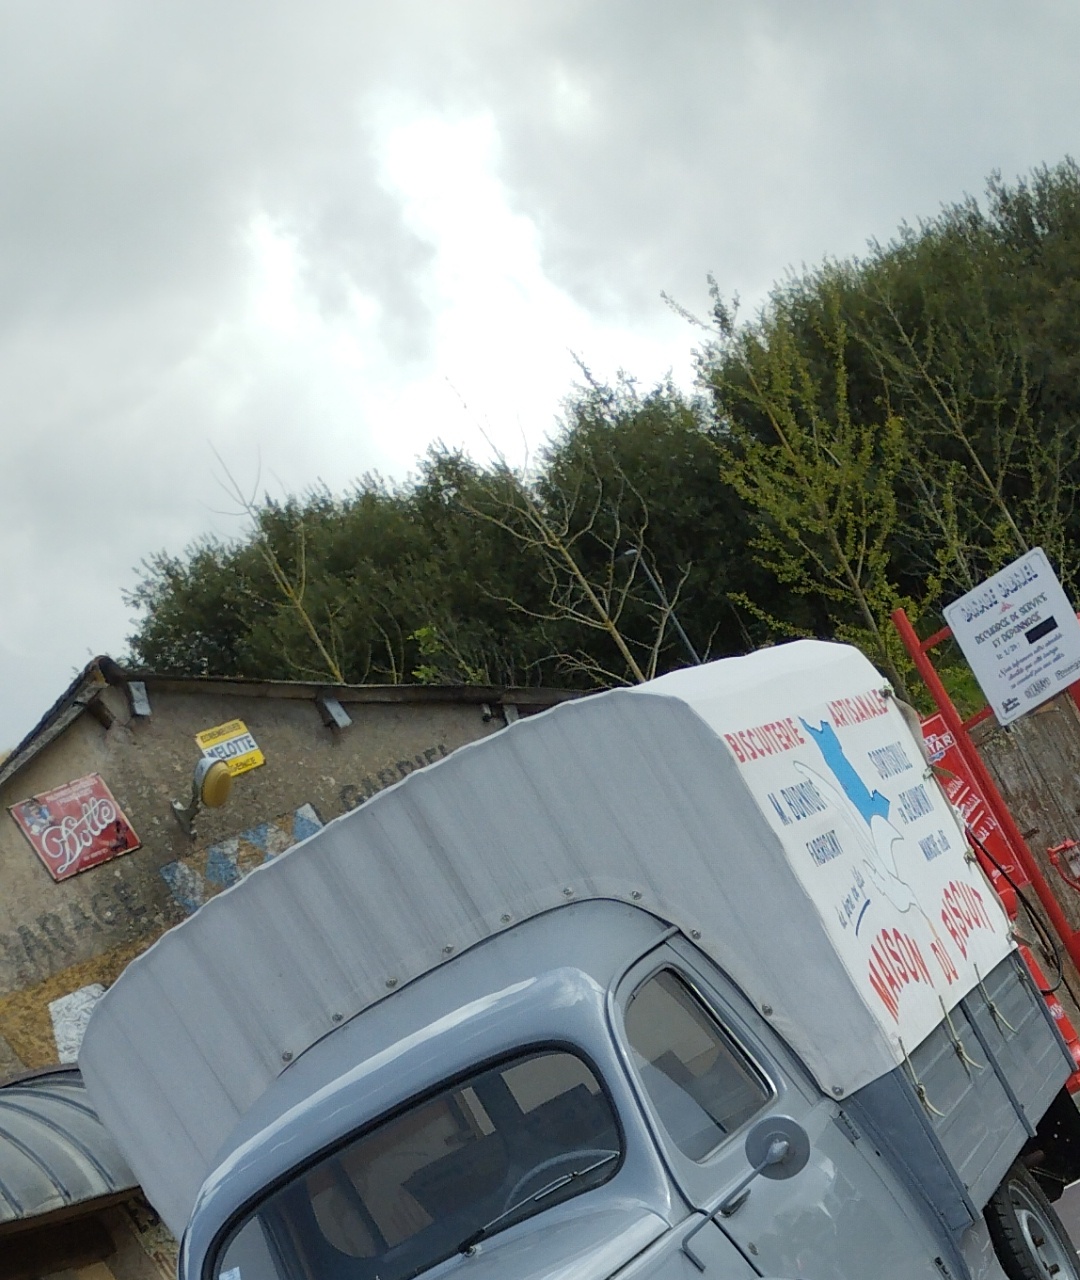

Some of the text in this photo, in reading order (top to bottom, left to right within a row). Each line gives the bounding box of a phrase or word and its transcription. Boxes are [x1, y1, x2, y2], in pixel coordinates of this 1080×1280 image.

[1008, 610, 1019, 622] DE
[1018, 591, 1048, 616] SERVICE
[991, 637, 1001, 648] ET
[724, 689, 889, 763] BISCUITERIE ARTISANALE
[768, 793, 792, 826] M.
[869, 880, 996, 1024] MAISON DU BISCUIT
